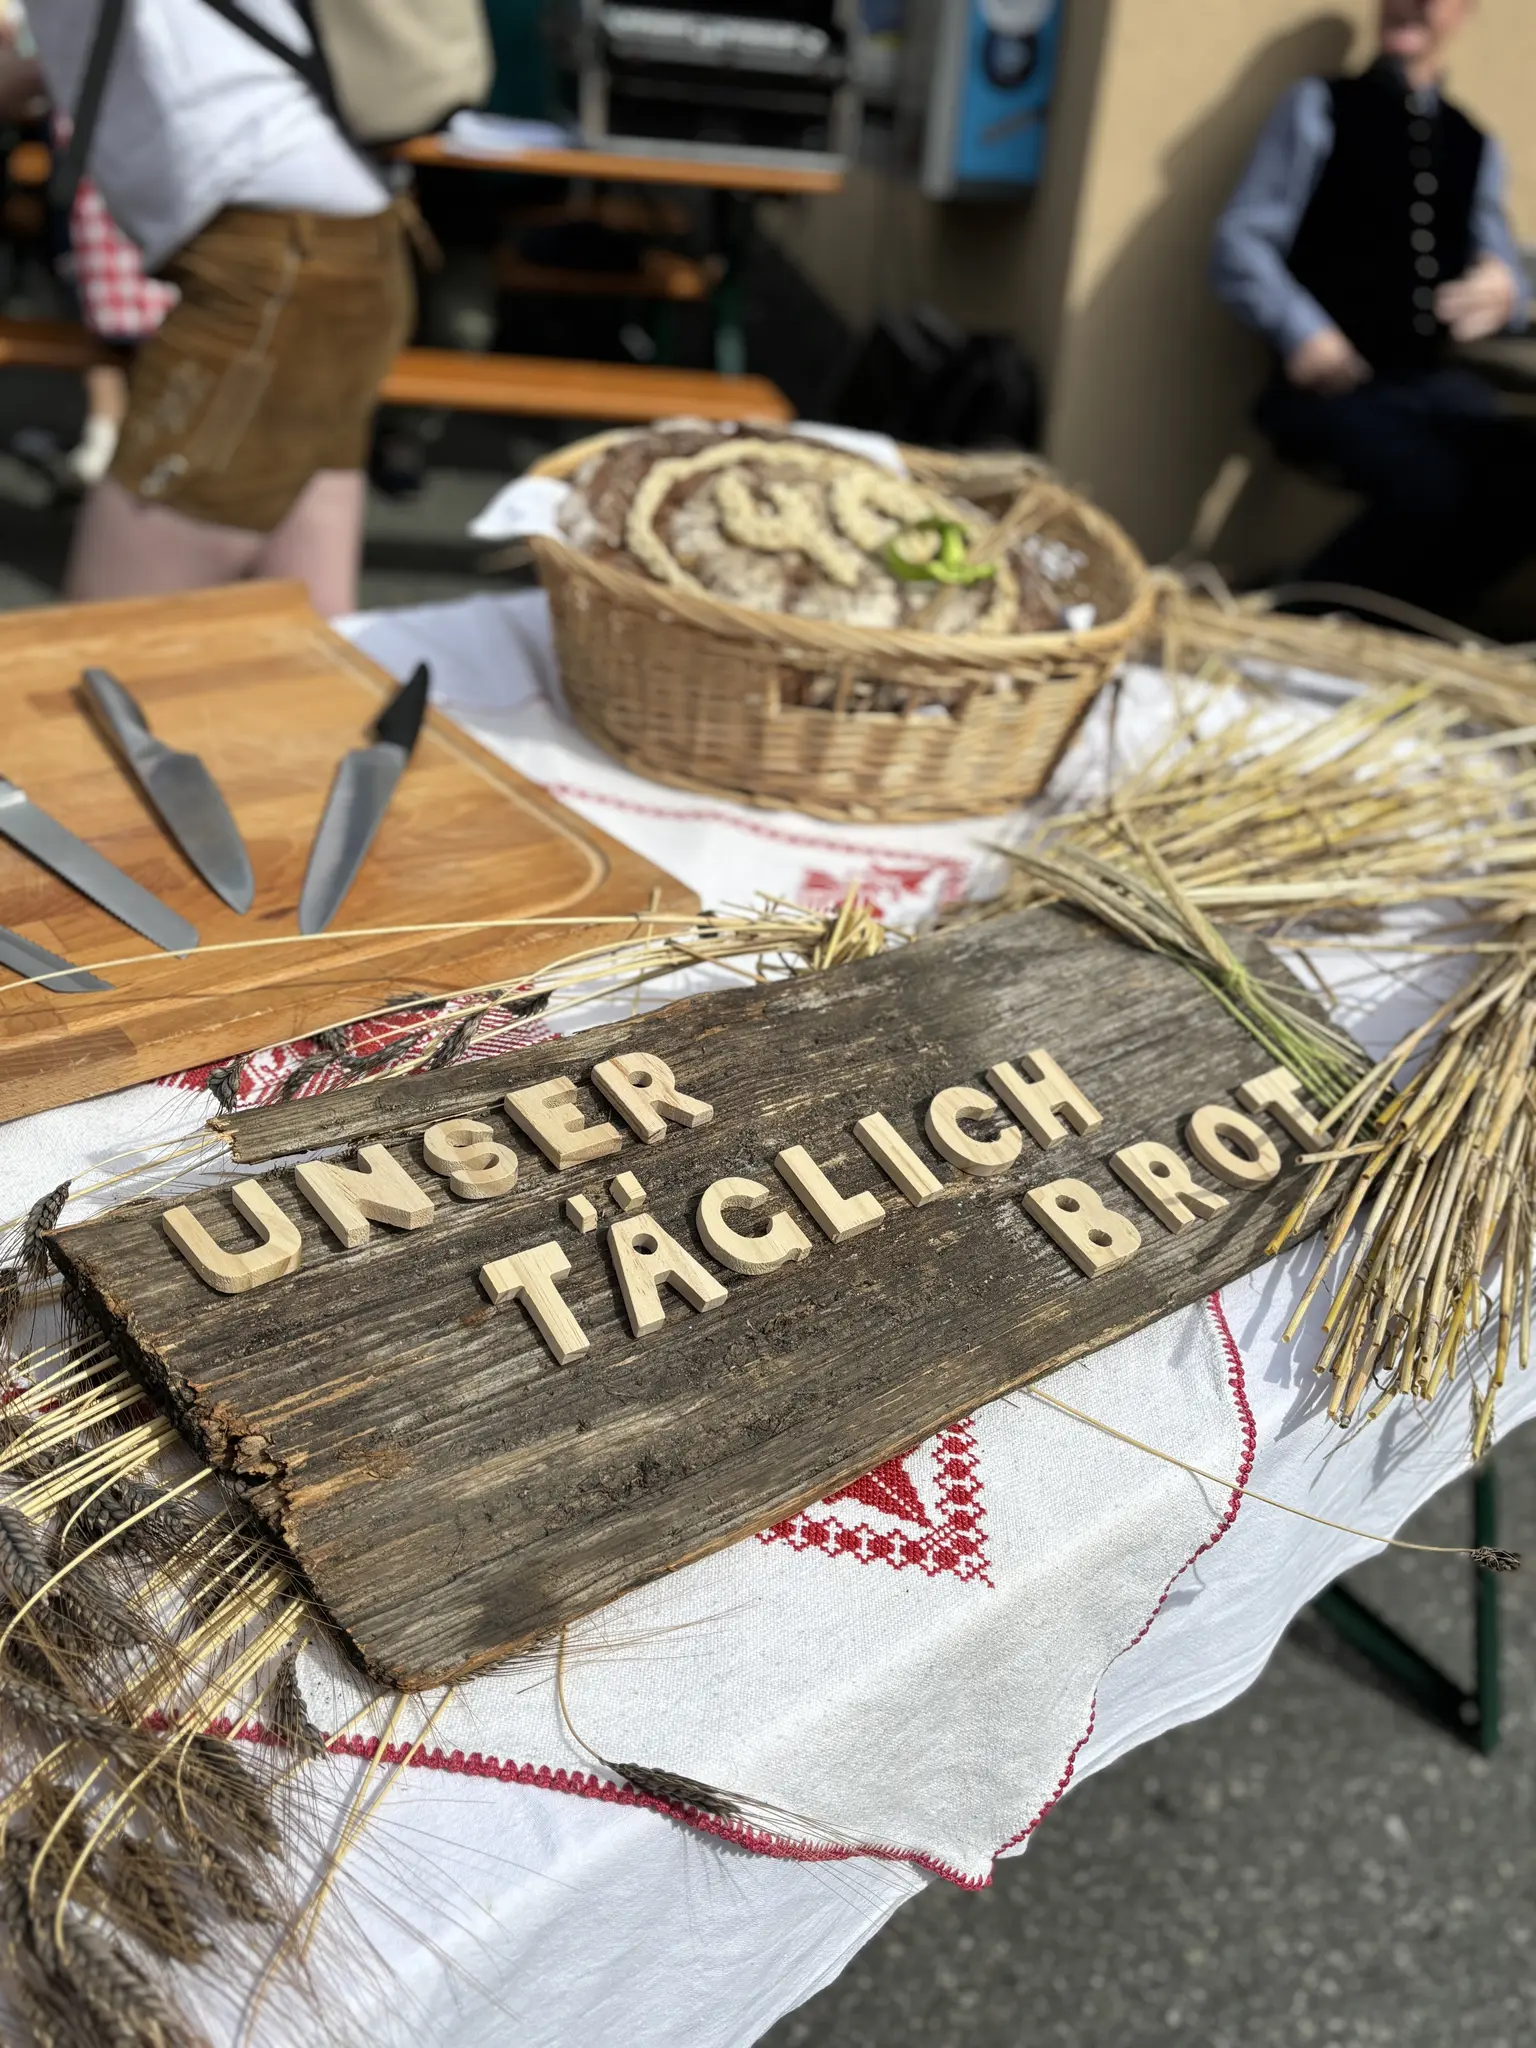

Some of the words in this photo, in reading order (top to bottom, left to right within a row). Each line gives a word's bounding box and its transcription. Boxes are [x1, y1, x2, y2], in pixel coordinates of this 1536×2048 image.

[162, 1052, 715, 1295] UNSER
[479, 1048, 1104, 1366] TÄGLICH
[1022, 1066, 1335, 1279] BROT
